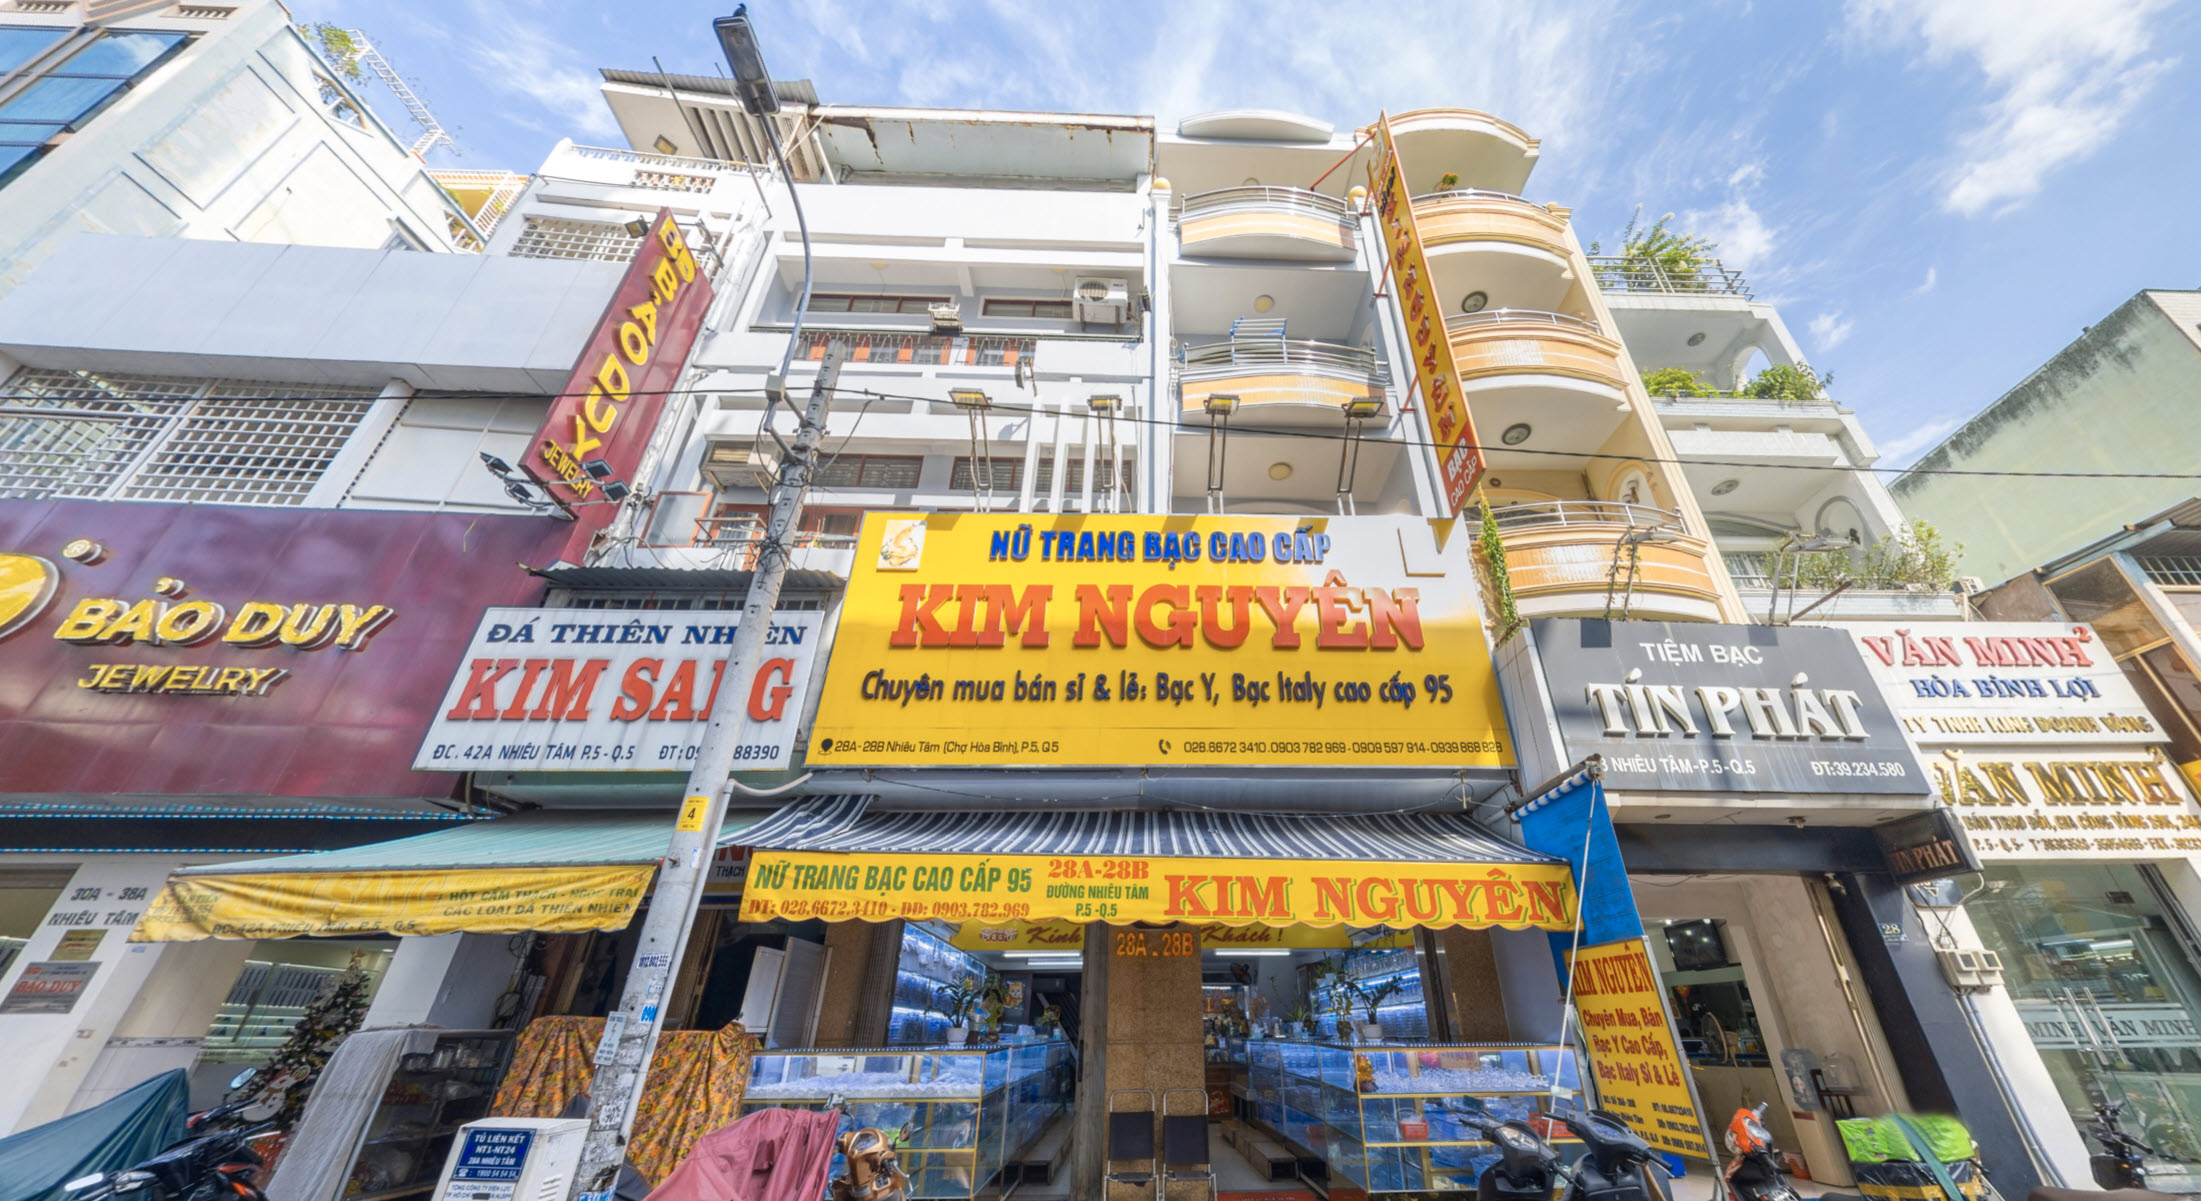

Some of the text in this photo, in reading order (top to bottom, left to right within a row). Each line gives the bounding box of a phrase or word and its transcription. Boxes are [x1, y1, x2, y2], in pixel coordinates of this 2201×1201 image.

[543, 438, 593, 500] JEWELRY
[1447, 437, 1468, 482] BẠC
[1451, 479, 1465, 507] CAO
[989, 523, 1331, 569] NỮ TRANG BẠC CAO CẤP
[54, 577, 392, 648] BẢO DUY
[890, 569, 1425, 650] KIM NGUYÊN
[487, 617, 807, 645] ĐÁ THIÊN NHÊN
[1640, 639, 1764, 668] TIỆM BẠC
[1862, 629, 1961, 667] VĂN
[78, 664, 286, 694] JEWELRY
[446, 658, 610, 721] KIM
[861, 669, 944, 707] Chuyên
[953, 677, 1006, 701] mua
[1014, 670, 1057, 701] bán
[1094, 673, 1111, 701] &
[1156, 672, 1195, 706] Bạc
[1201, 672, 1220, 706] Y,
[1232, 672, 1270, 707] Bạc
[1278, 671, 1326, 709] Italy
[1334, 679, 1372, 702] cao
[1379, 670, 1416, 710] cấp
[1424, 674, 1453, 704] 95
[1910, 674, 2101, 702] HÒA BÌNH LỢI
[1585, 668, 1871, 739] TÍN PHÁT
[1931, 716, 1985, 733] TNHH
[463, 744, 493, 760] 42A
[498, 742, 540, 760] NHIÊU
[546, 742, 577, 760] TÂM
[580, 745, 602, 760] P.5
[611, 745, 636, 762] Q.5
[887, 739, 916, 753] Nhiêu
[919, 740, 940, 753] Tâm
[970, 740, 990, 753] Hòa
[1184, 742, 1237, 754] 028.6672
[1302, 742, 1324, 754] 782
[1384, 741, 1404, 754] 597
[1460, 741, 1481, 753] 868
[1612, 756, 1657, 773] NHIÊU
[688, 808, 696, 820] 4
[1913, 835, 1959, 869] PHÁT
[754, 858, 1032, 896] NỮ TRANG BẠC CAO CẤP 95
[1048, 859, 1149, 879] 28A-28B
[70, 887, 148, 901] 30A 38A
[1046, 882, 1149, 900] ĐƯỜNG NHIÊU TÂM
[1164, 868, 1568, 923] KIM NGUYÊN
[48, 910, 140, 926] NHIÊU TÂM
[932, 902, 1029, 917] 0903.782.969
[1026, 926, 1082, 945] Kinh
[1882, 923, 1901, 934] 28
[1117, 932, 1194, 957] 28A 28B
[1592, 941, 1654, 995] NGUYÊN
[48, 980, 82, 993] DUY
[1583, 1009, 1616, 1030] Chuyên
[1615, 1008, 1642, 1030] Mua,
[1592, 1034, 1611, 1058] Bạc
[1611, 1034, 1619, 1053] Y
[1620, 1034, 1641, 1054] Cao
[1597, 1061, 1616, 1085] Bạc
[1616, 1062, 1640, 1086] Italy
[1653, 1065, 1664, 1085] &
[487, 1133, 507, 1143] LIÊN
